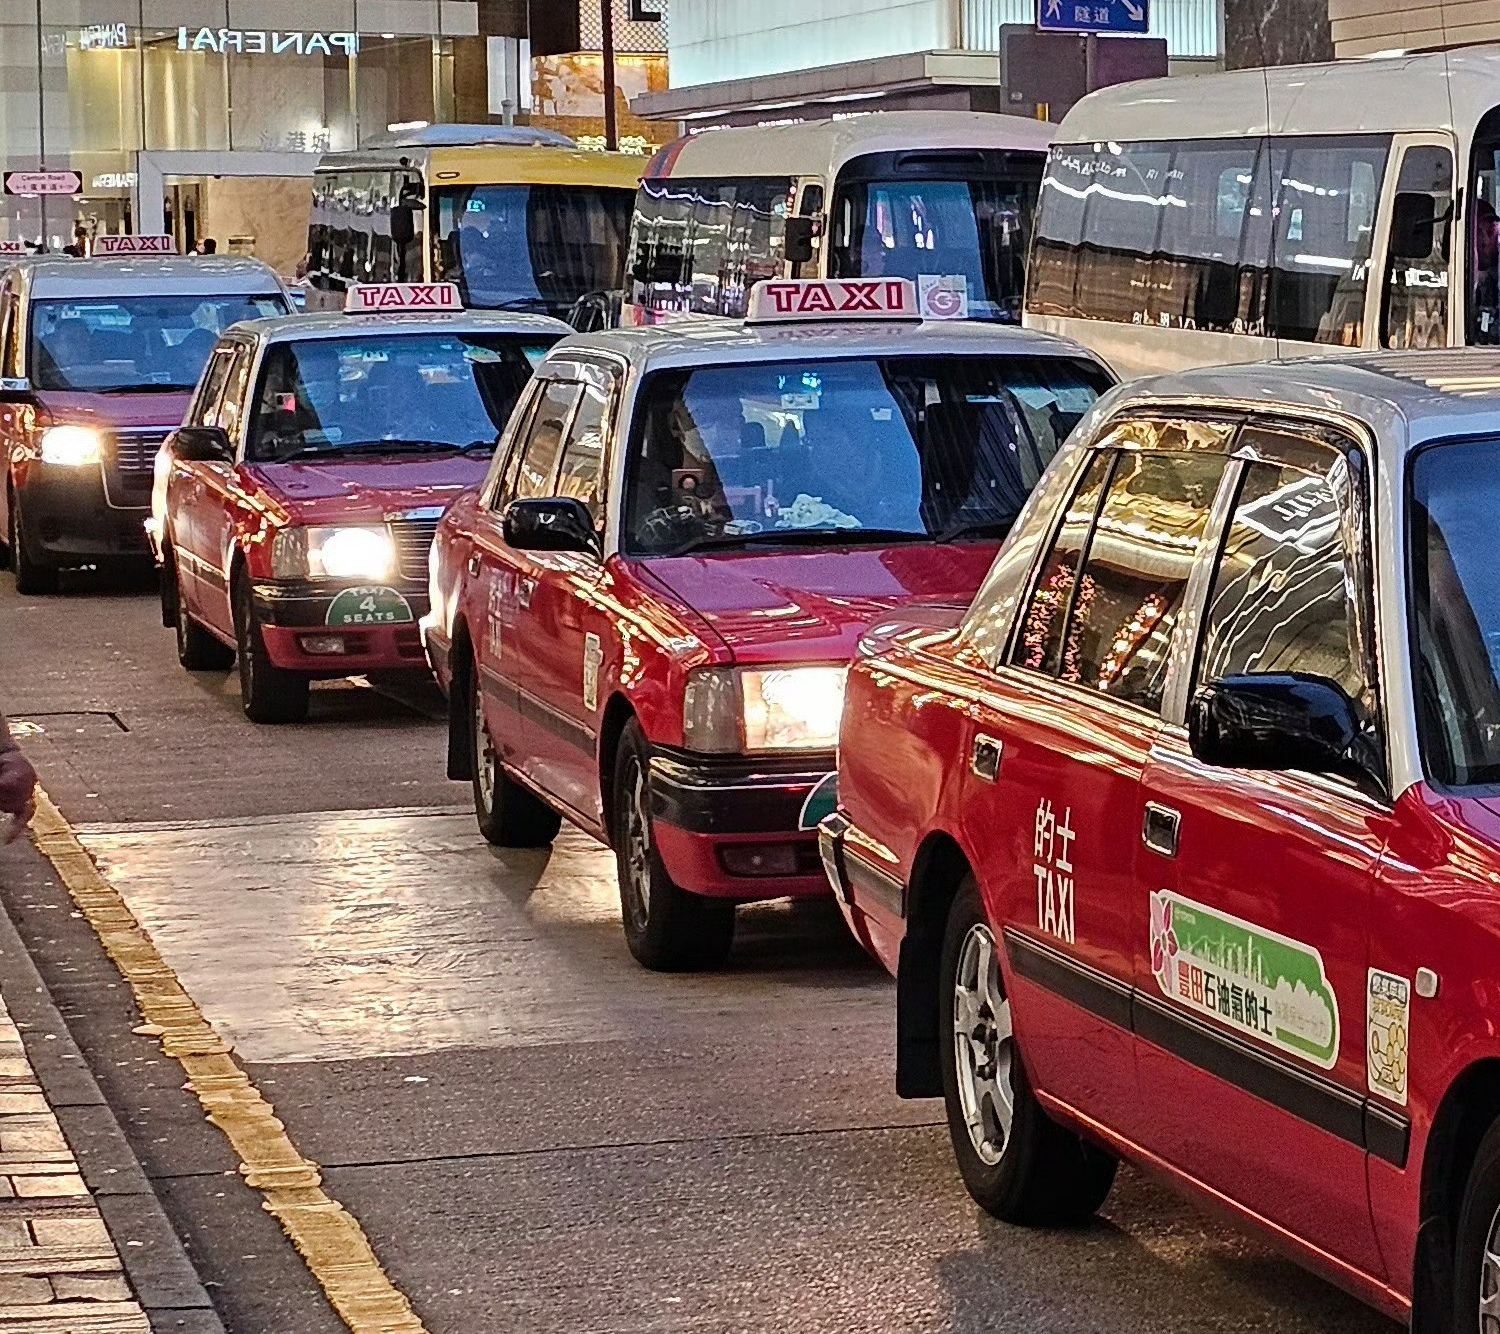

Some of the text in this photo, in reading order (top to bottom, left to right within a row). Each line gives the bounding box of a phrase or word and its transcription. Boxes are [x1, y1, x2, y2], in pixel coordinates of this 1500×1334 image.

[1074, 5, 1110, 24] 隧道
[101, 236, 170, 251] TAXI
[358, 285, 452, 306] TAXI
[767, 281, 903, 312] TAXI
[359, 596, 376, 611] 4
[343, 612, 395, 623] SEATS
[1034, 797, 1076, 873] 的士
[1034, 864, 1075, 944] TAXI
